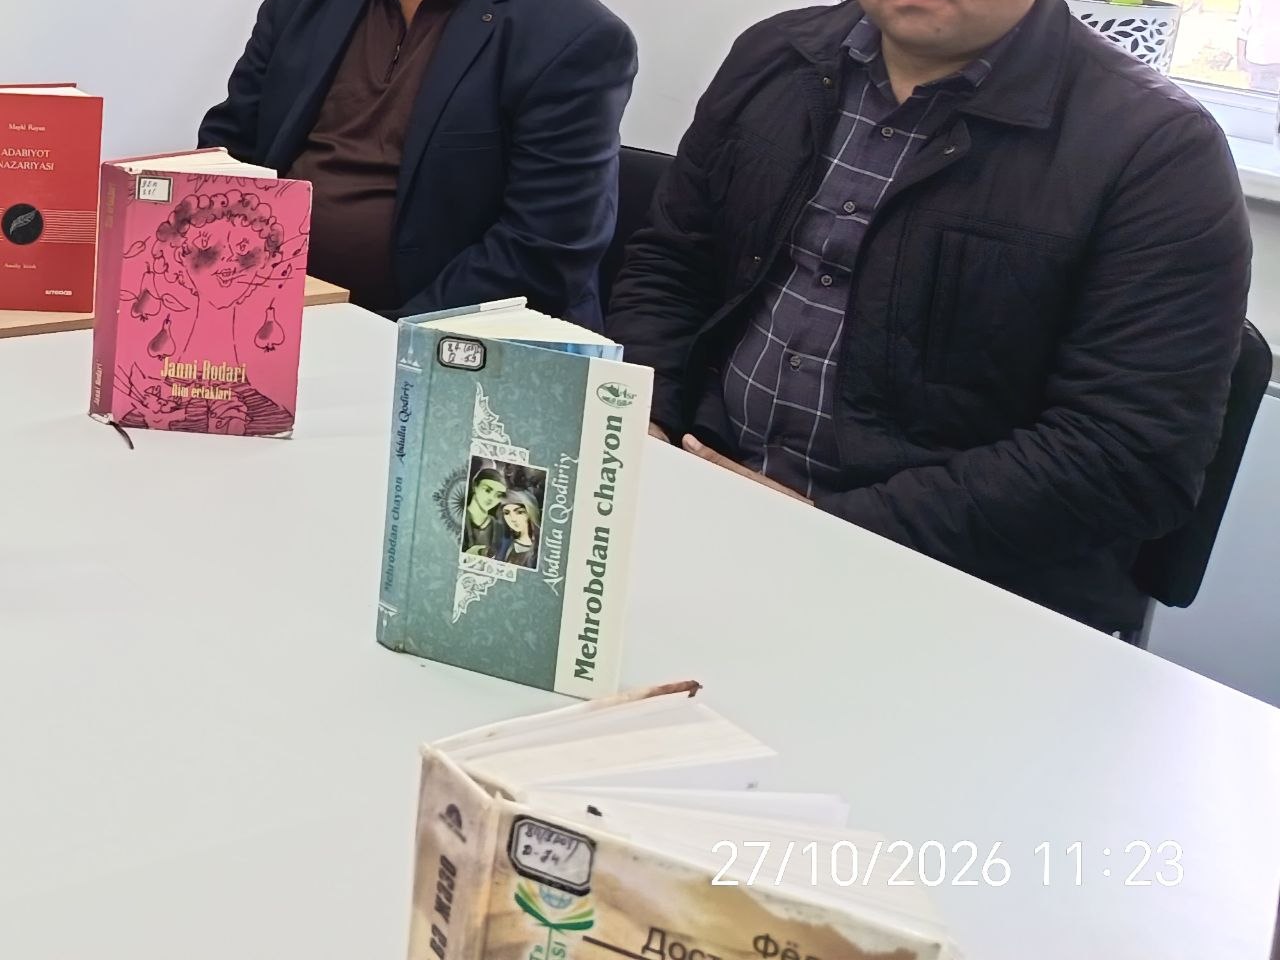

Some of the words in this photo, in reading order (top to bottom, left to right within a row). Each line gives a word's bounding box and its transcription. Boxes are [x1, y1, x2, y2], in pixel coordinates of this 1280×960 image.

[1, 148, 51, 158] ADABIYOT
[160, 357, 198, 380] Janni
[398, 380, 414, 423] Qodiriy
[390, 476, 404, 521] chayon
[549, 452, 580, 524] Qodiriy
[383, 523, 399, 593] Mehrobdan
[542, 527, 564, 596] Abdulla
[573, 525, 611, 681] Mehrobdan
[593, 415, 624, 517] chayon
